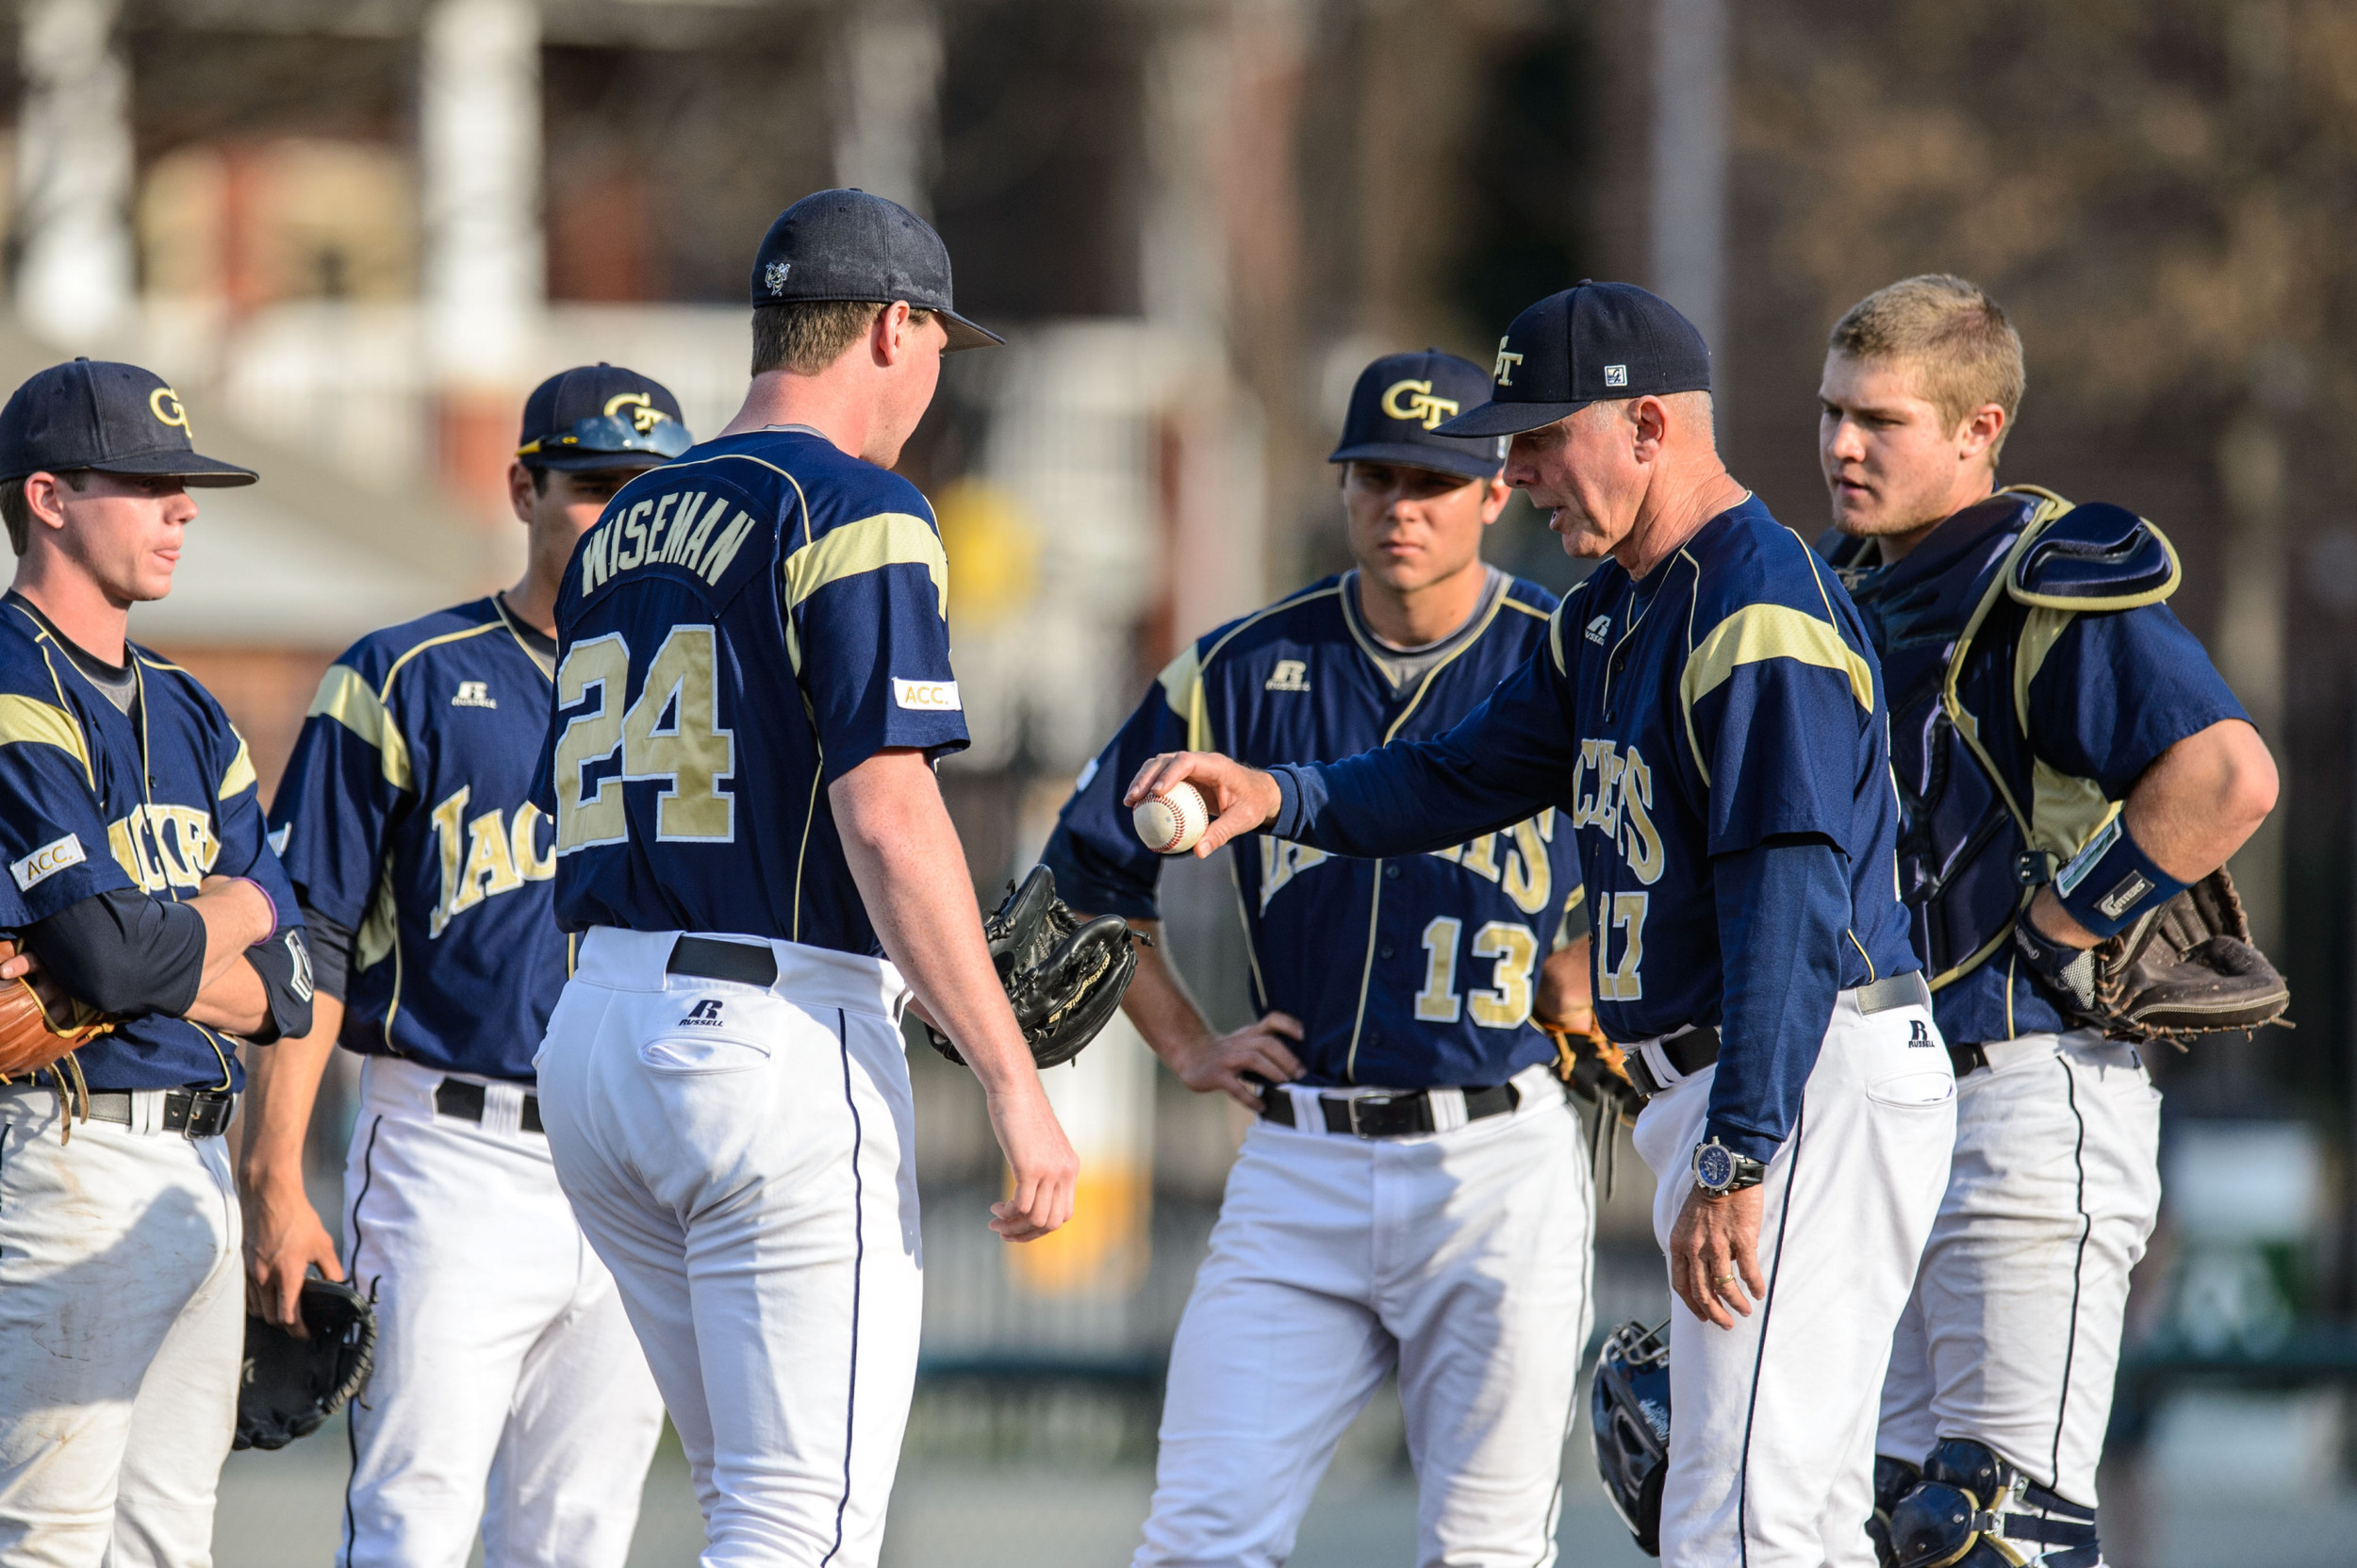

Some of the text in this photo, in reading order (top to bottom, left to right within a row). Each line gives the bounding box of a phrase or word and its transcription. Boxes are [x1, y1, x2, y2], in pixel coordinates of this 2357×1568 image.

[1381, 379, 1459, 431] GT
[582, 491, 755, 597] WISEMAN
[905, 685, 948, 704] ACC.
[554, 623, 734, 857] 24
[26, 845, 73, 881] ACC.
[429, 784, 556, 939] JAC
[1414, 915, 1539, 1030] 13
[1597, 891, 1649, 1001] 17
[679, 1018, 724, 1028] RUSSELL
[1908, 1040, 1936, 1048] RUSSELL
